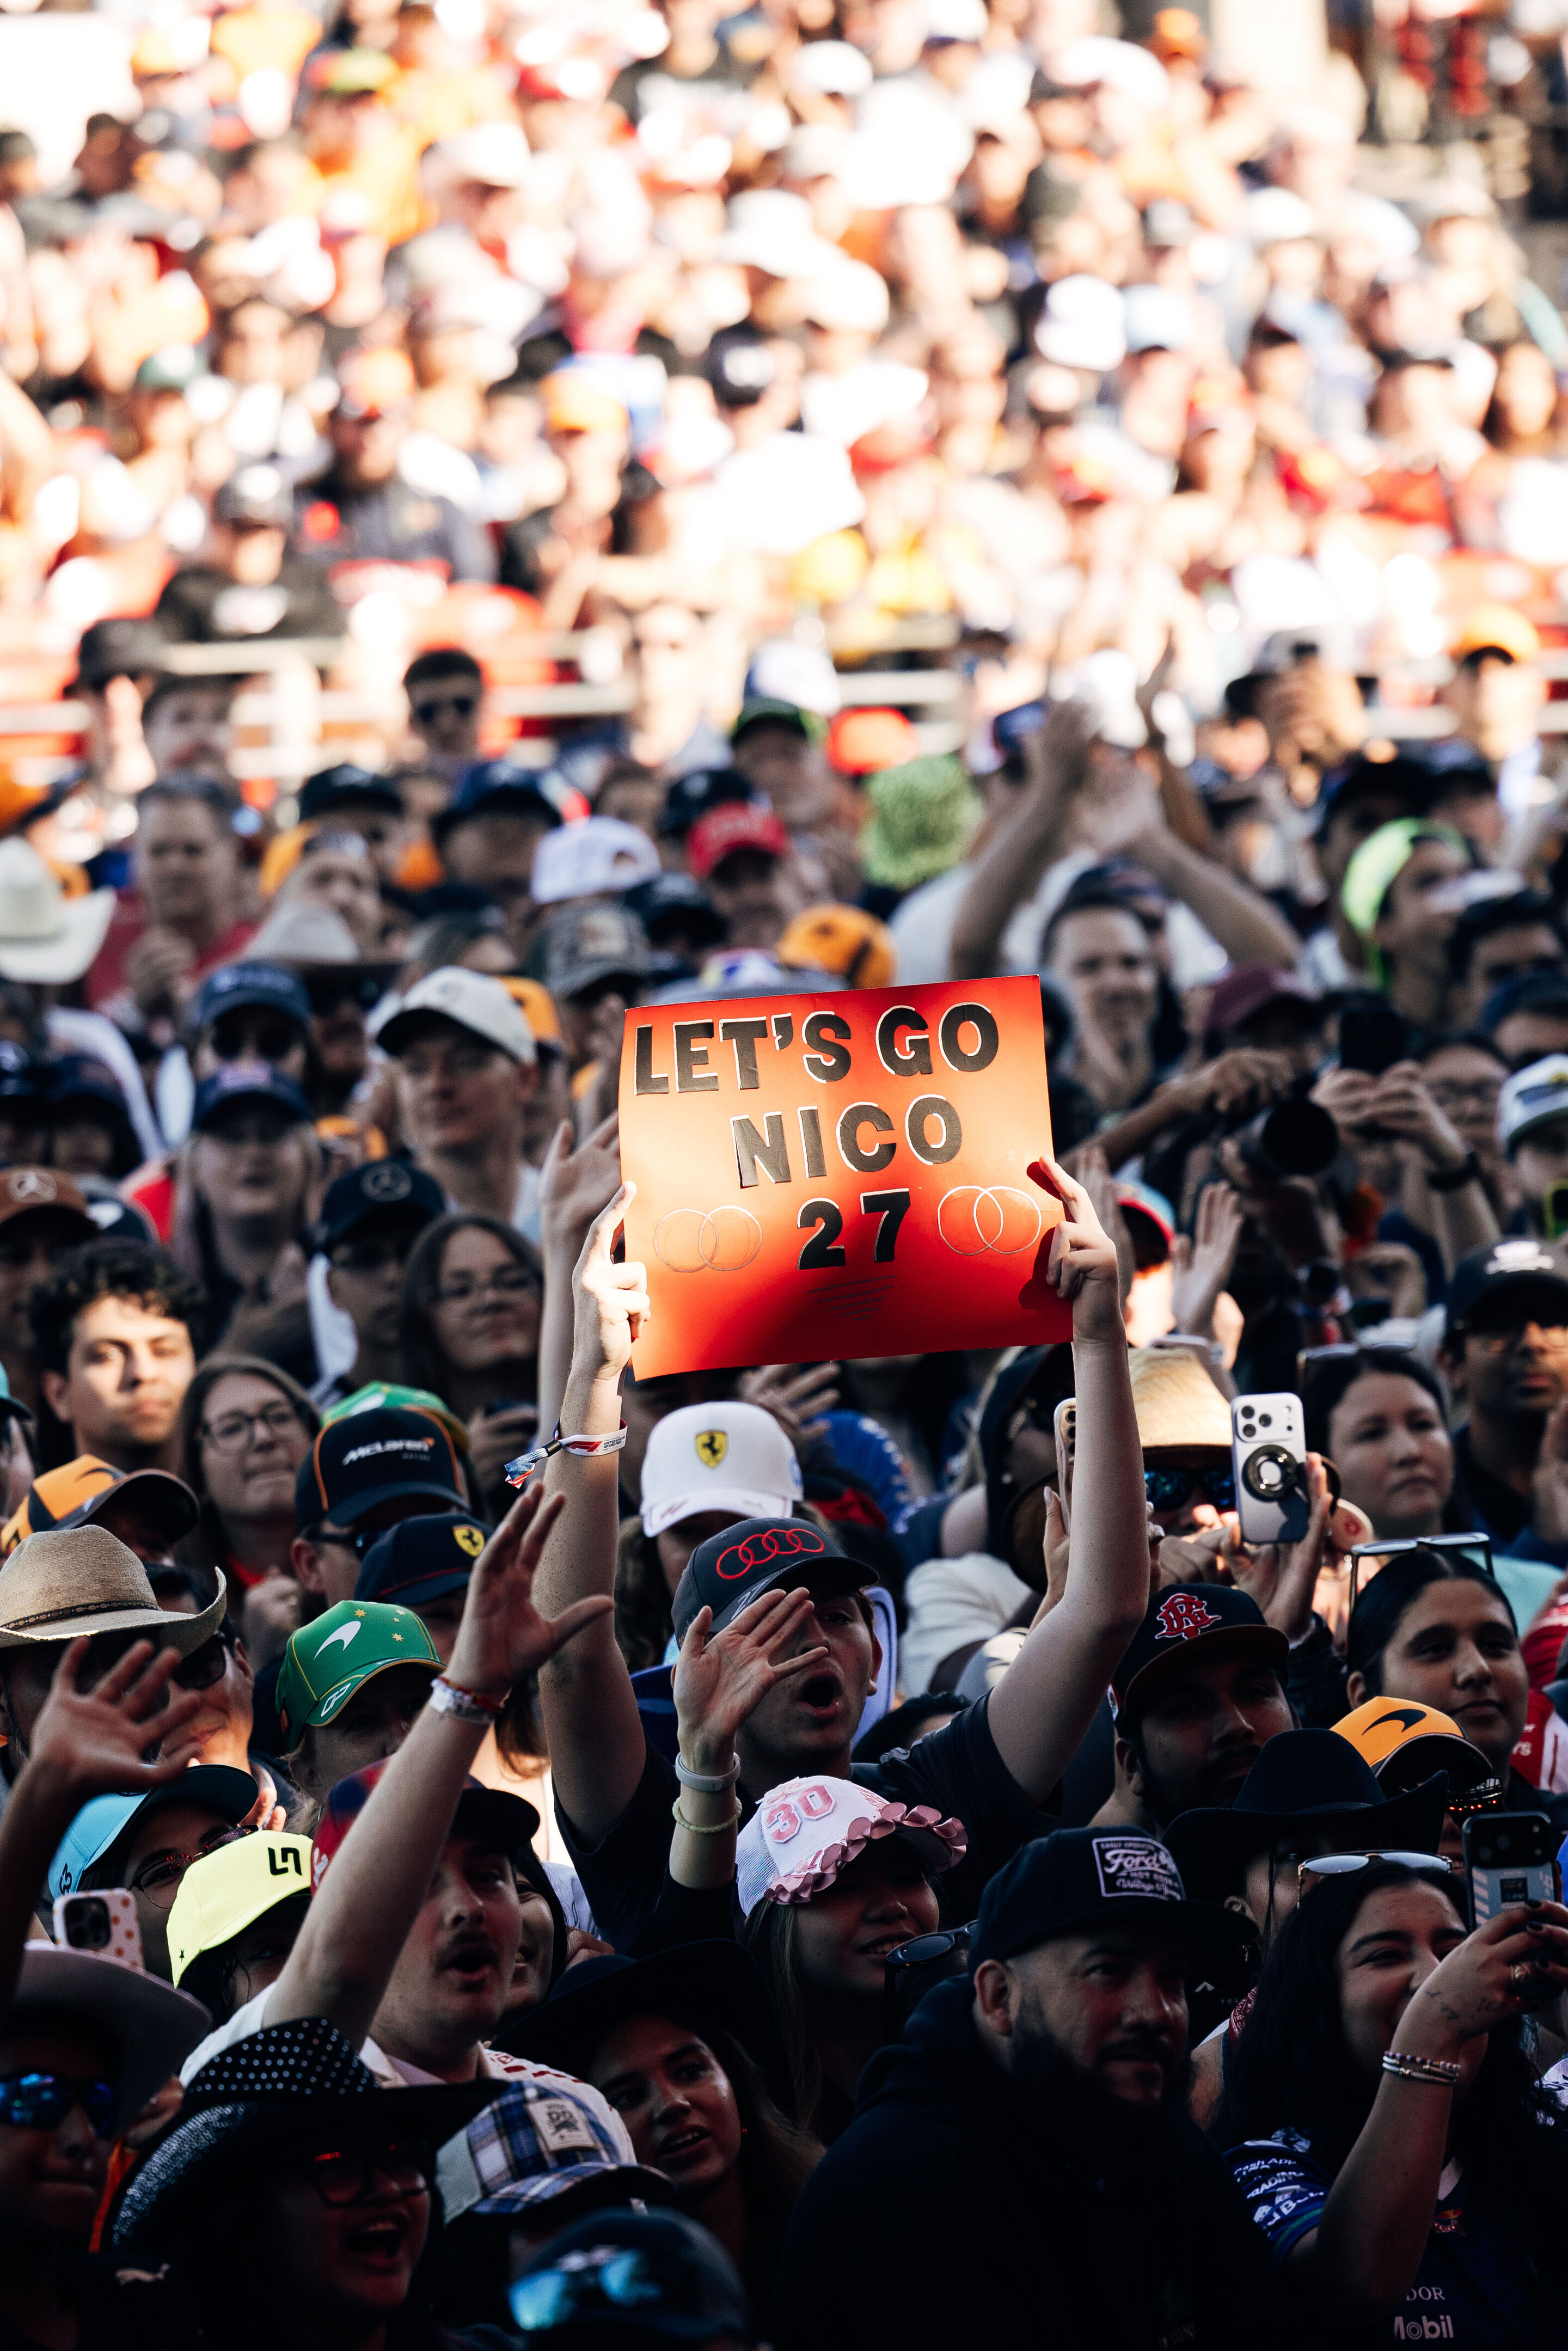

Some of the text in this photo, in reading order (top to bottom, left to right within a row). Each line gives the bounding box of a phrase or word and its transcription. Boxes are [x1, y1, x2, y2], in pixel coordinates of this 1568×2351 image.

[634, 1002, 999, 1095] LET'S GO
[730, 1094, 963, 1188] NICO
[797, 1189, 910, 1270] 27
[766, 1784, 836, 1844] 30
[1104, 1849, 1161, 1874] Ford
[1393, 2315, 1455, 2340] Mobil
